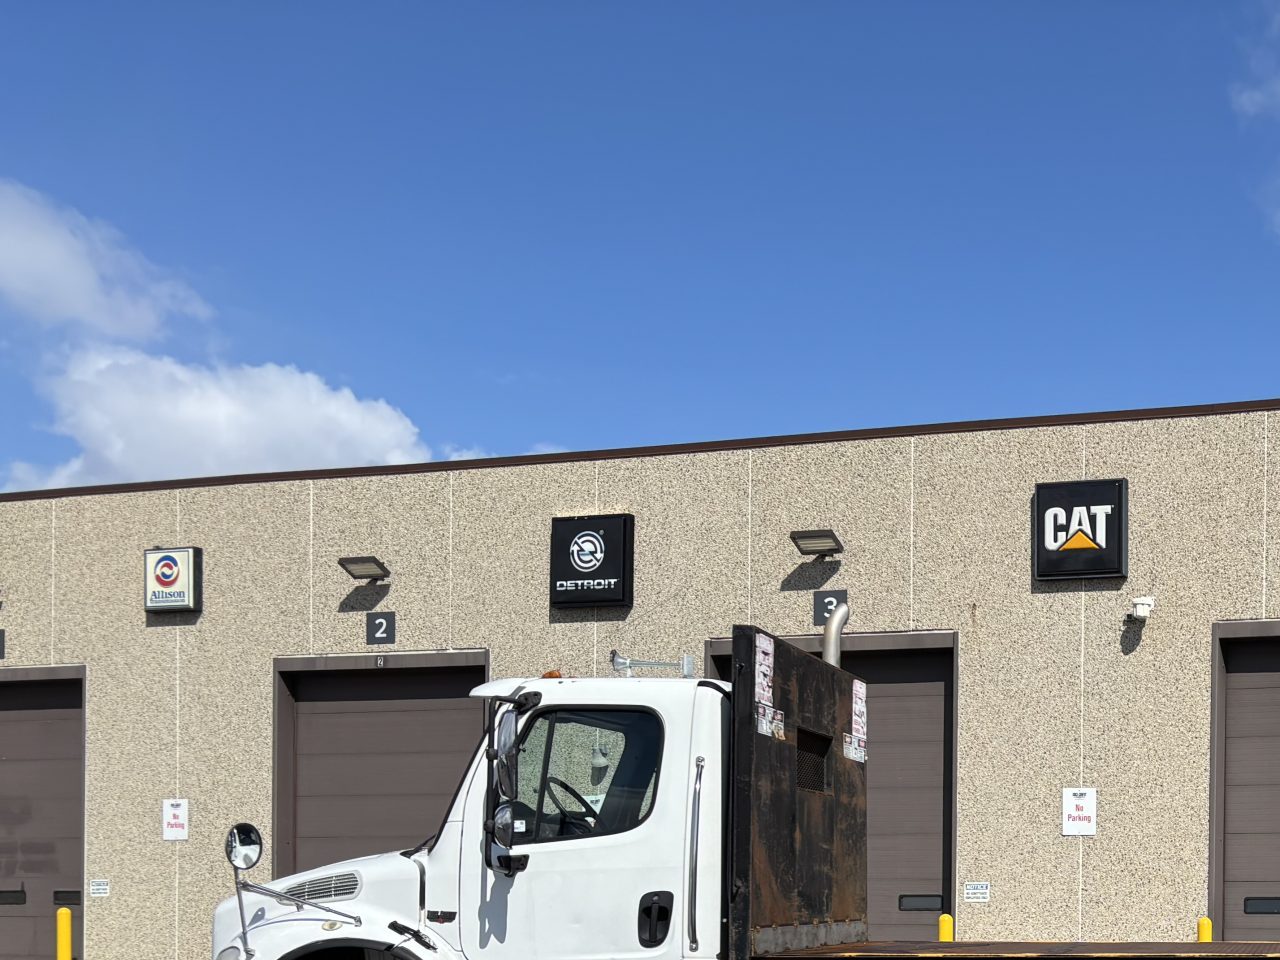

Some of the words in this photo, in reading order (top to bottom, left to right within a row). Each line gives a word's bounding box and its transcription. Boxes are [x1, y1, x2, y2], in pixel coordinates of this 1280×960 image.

[1044, 505, 1112, 552] CAT
[556, 579, 618, 591] DETROIT
[150, 591, 185, 600] Allison
[824, 597, 838, 618] 3
[374, 618, 387, 638] 2
[1075, 804, 1084, 812] No
[1067, 814, 1091, 823] Parking
